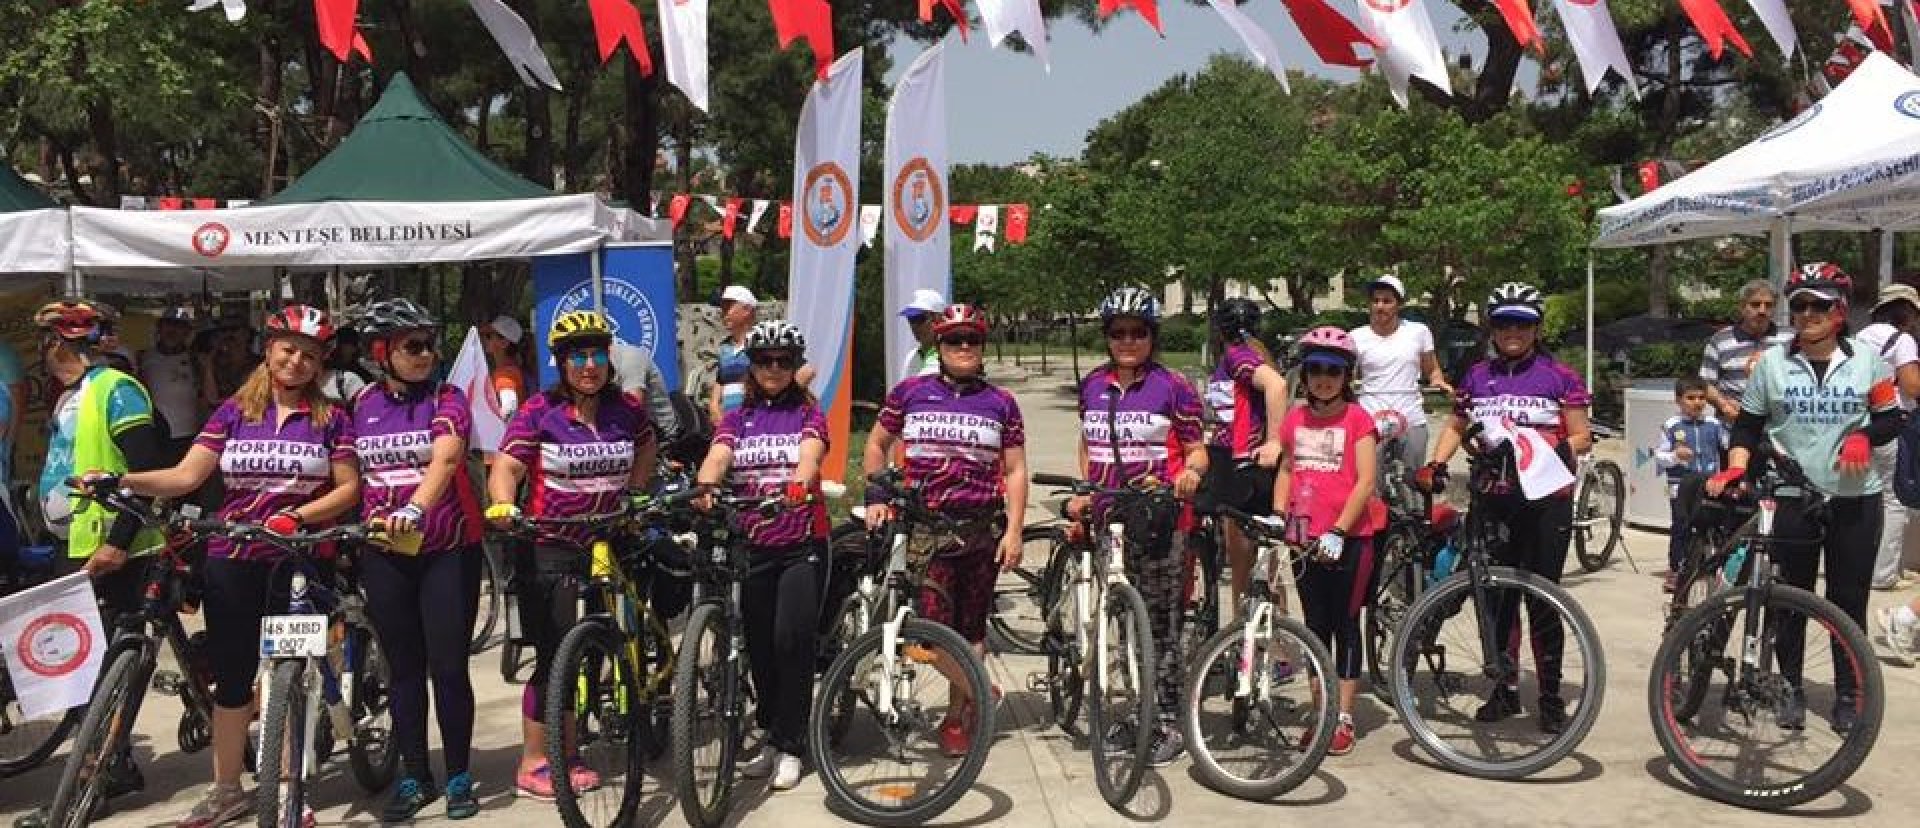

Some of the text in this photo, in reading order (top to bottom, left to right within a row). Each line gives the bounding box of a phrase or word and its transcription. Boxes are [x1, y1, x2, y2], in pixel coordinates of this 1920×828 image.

[244, 219, 472, 247] MENTEŞE BELEDİYESİ
[1784, 385, 1857, 397] MUĞLA
[919, 425, 979, 441] MUĞLA
[231, 455, 303, 473] MUĞLA
[569, 457, 630, 475] MUĞLA
[263, 620, 321, 635] 48 MBD
[278, 637, 307, 651] 007
